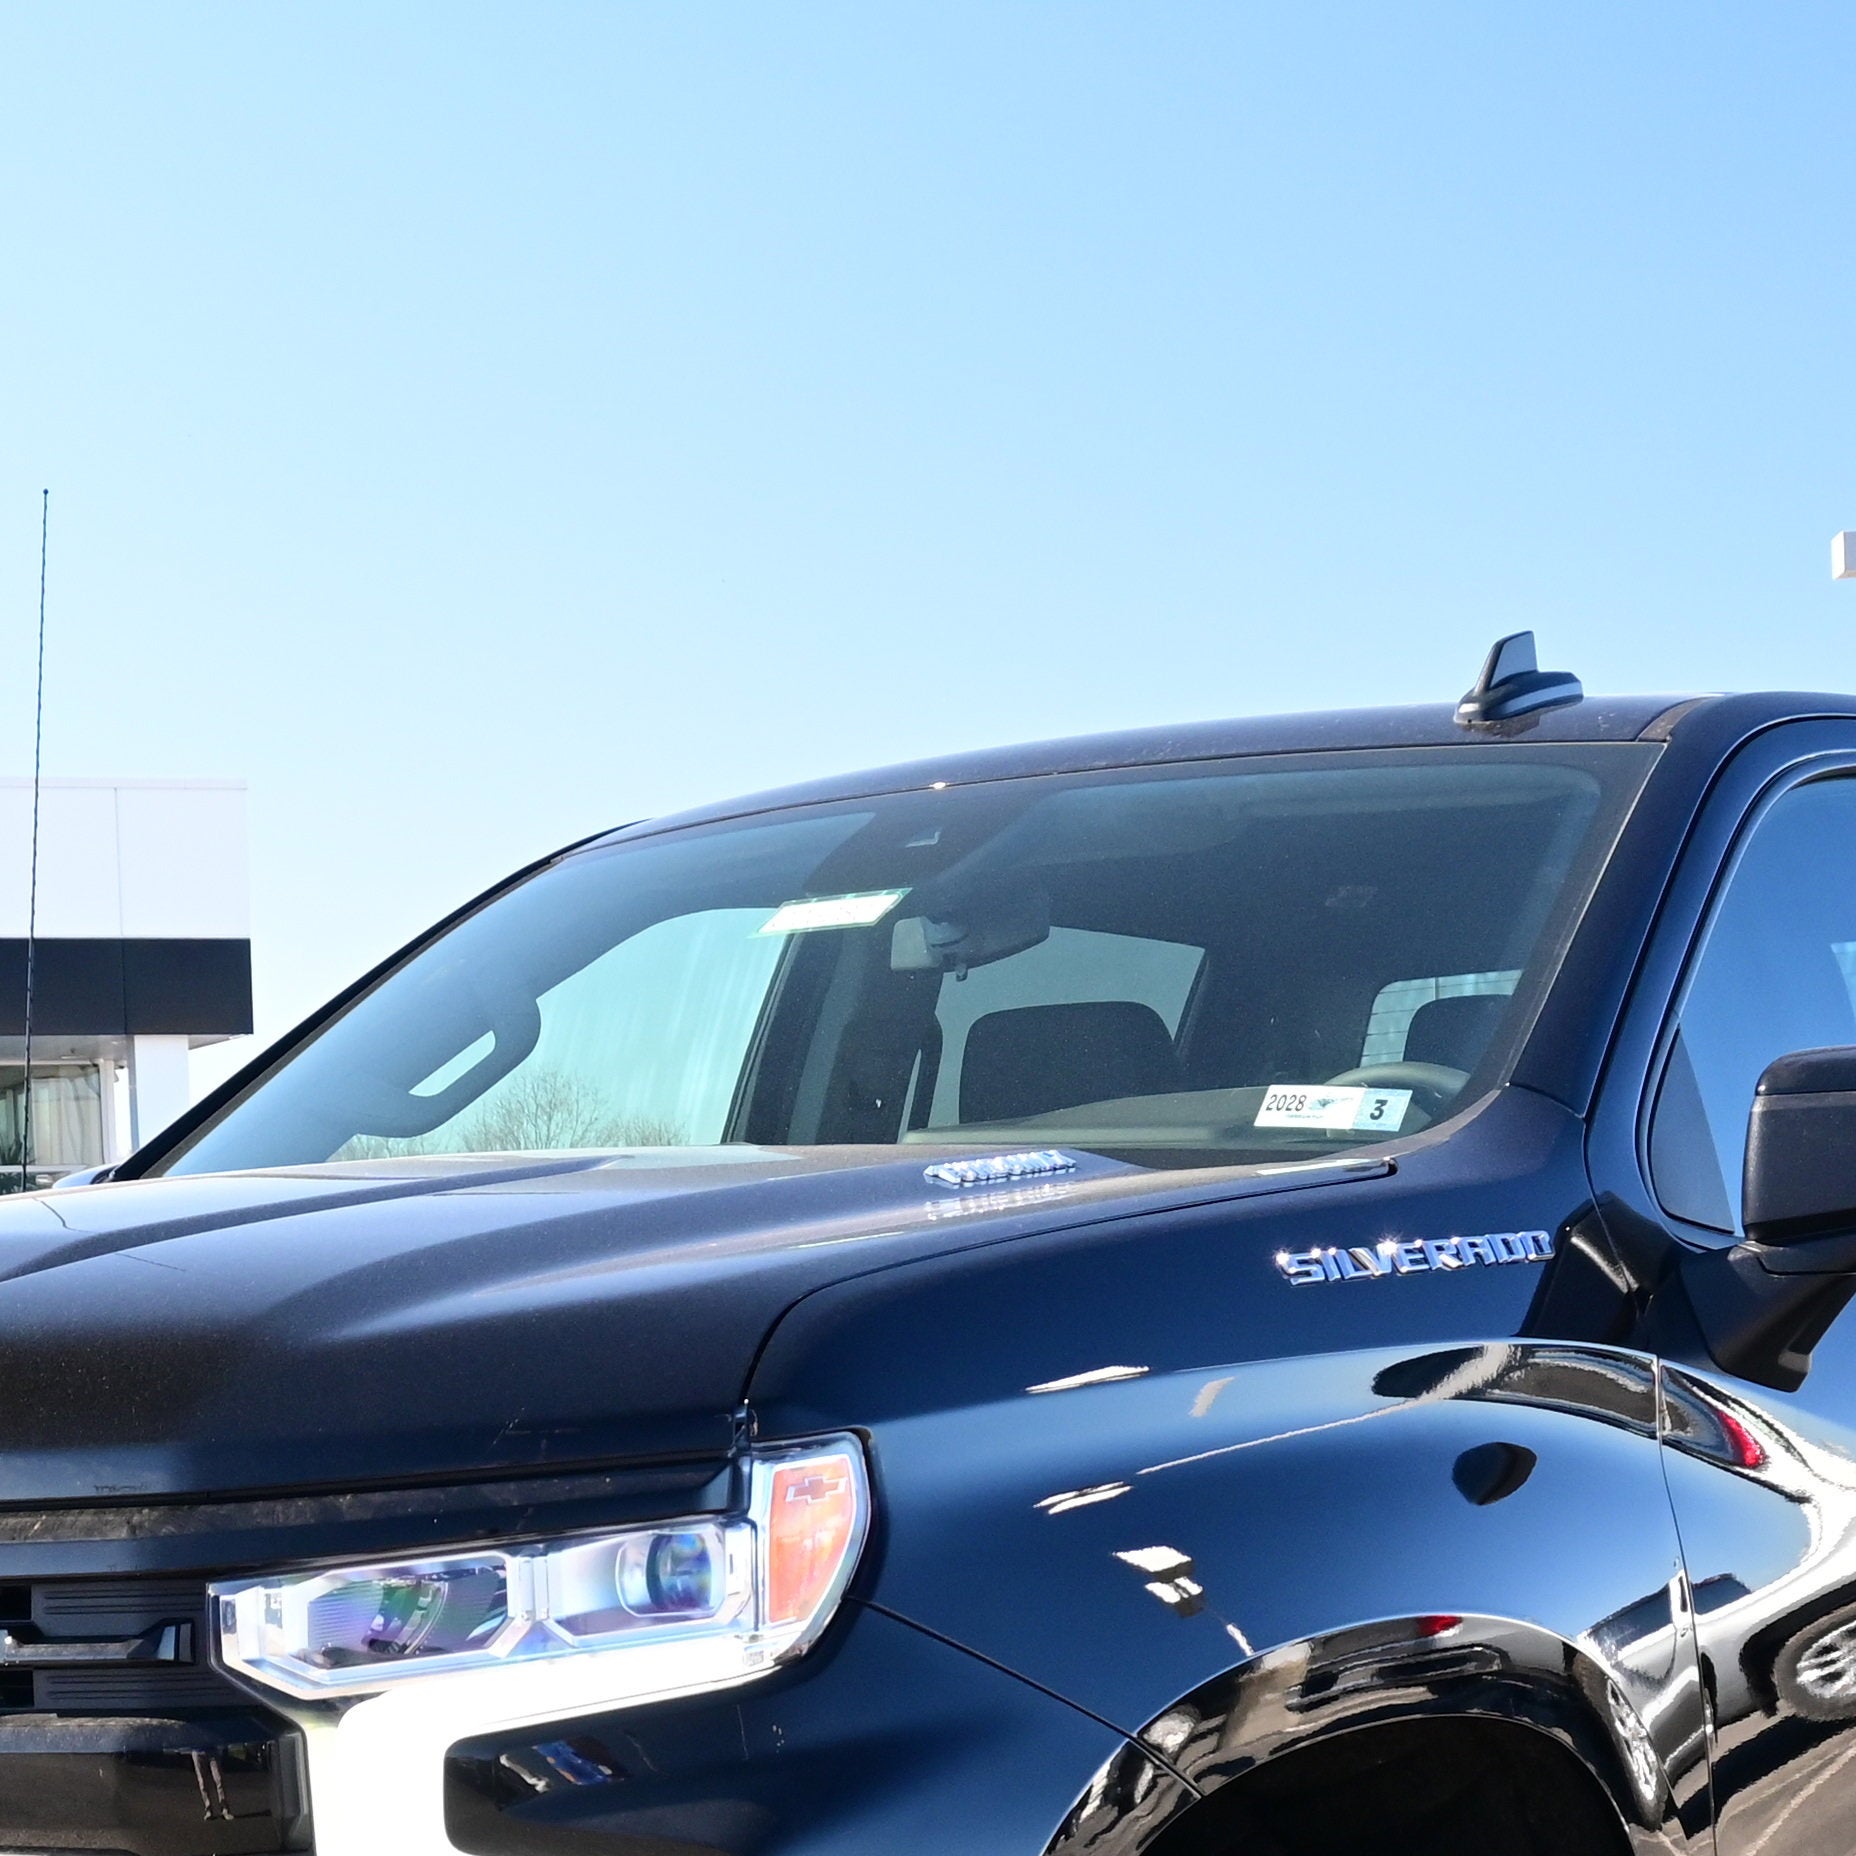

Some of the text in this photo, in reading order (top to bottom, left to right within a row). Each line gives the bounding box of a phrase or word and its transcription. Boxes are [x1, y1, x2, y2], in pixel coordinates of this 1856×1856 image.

[1265, 1094, 1307, 1112] 2028
[1369, 1099, 1389, 1120] 3
[1274, 1230, 1555, 1286] SILVERADO
